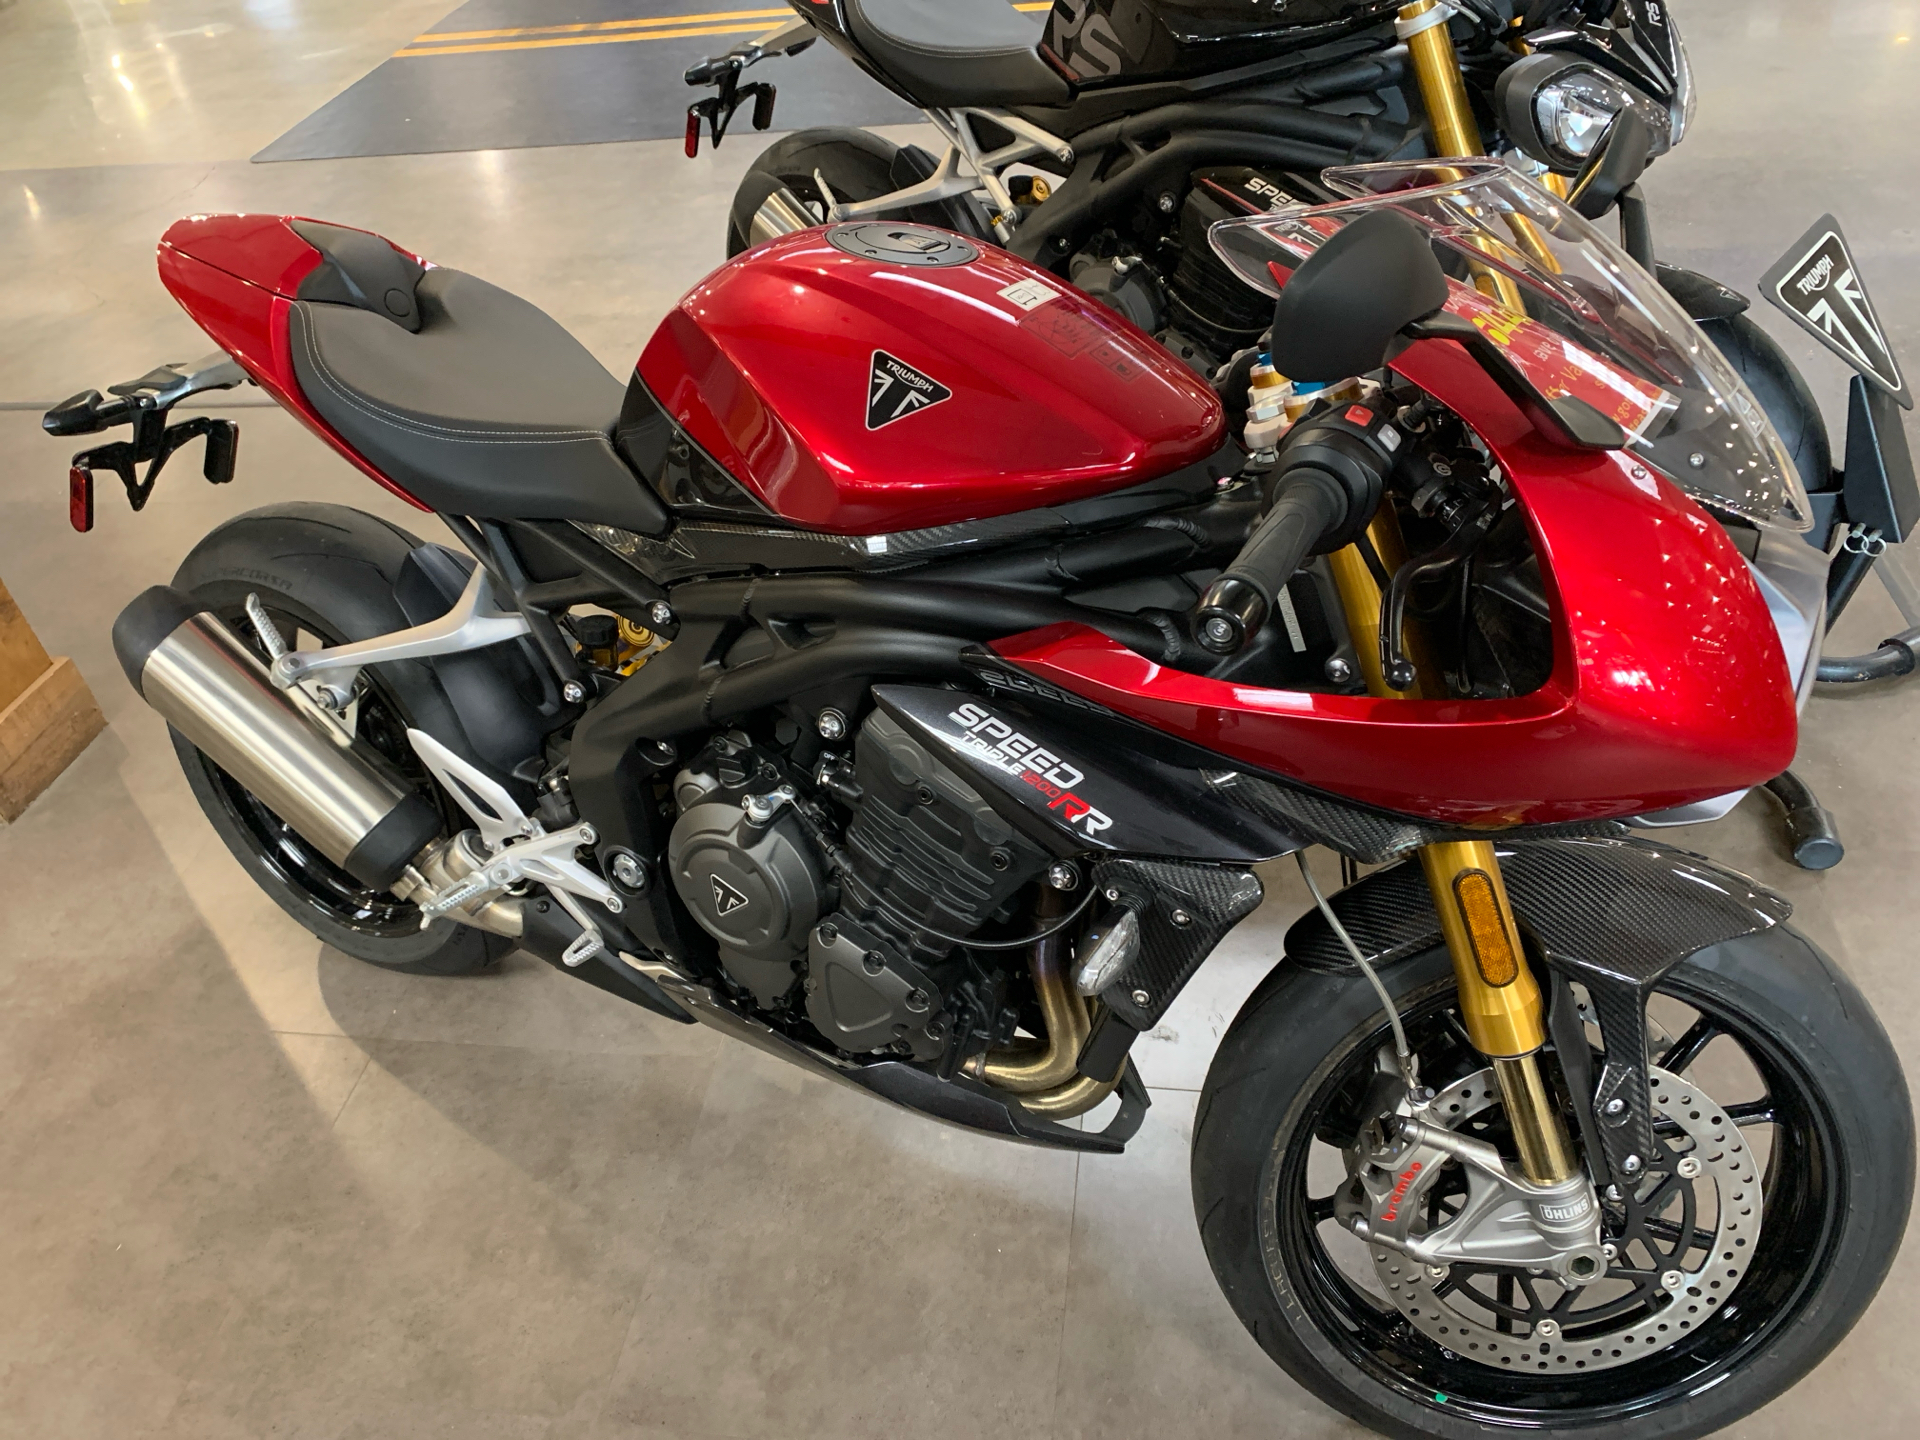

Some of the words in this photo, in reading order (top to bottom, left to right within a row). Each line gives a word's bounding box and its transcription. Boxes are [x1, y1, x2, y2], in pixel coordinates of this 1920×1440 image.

[1645, 1, 1662, 26] RS
[1053, 0, 1121, 77] RS
[1244, 177, 1304, 208] SPE
[1796, 254, 1834, 295] TRIUMPH
[886, 360, 934, 392] TRIUMPH
[947, 703, 1085, 789] SPEED
[1047, 792, 1113, 836] RR
[1381, 1162, 1422, 1222] brembo
[1543, 1199, 1588, 1219] ÖHLINS
